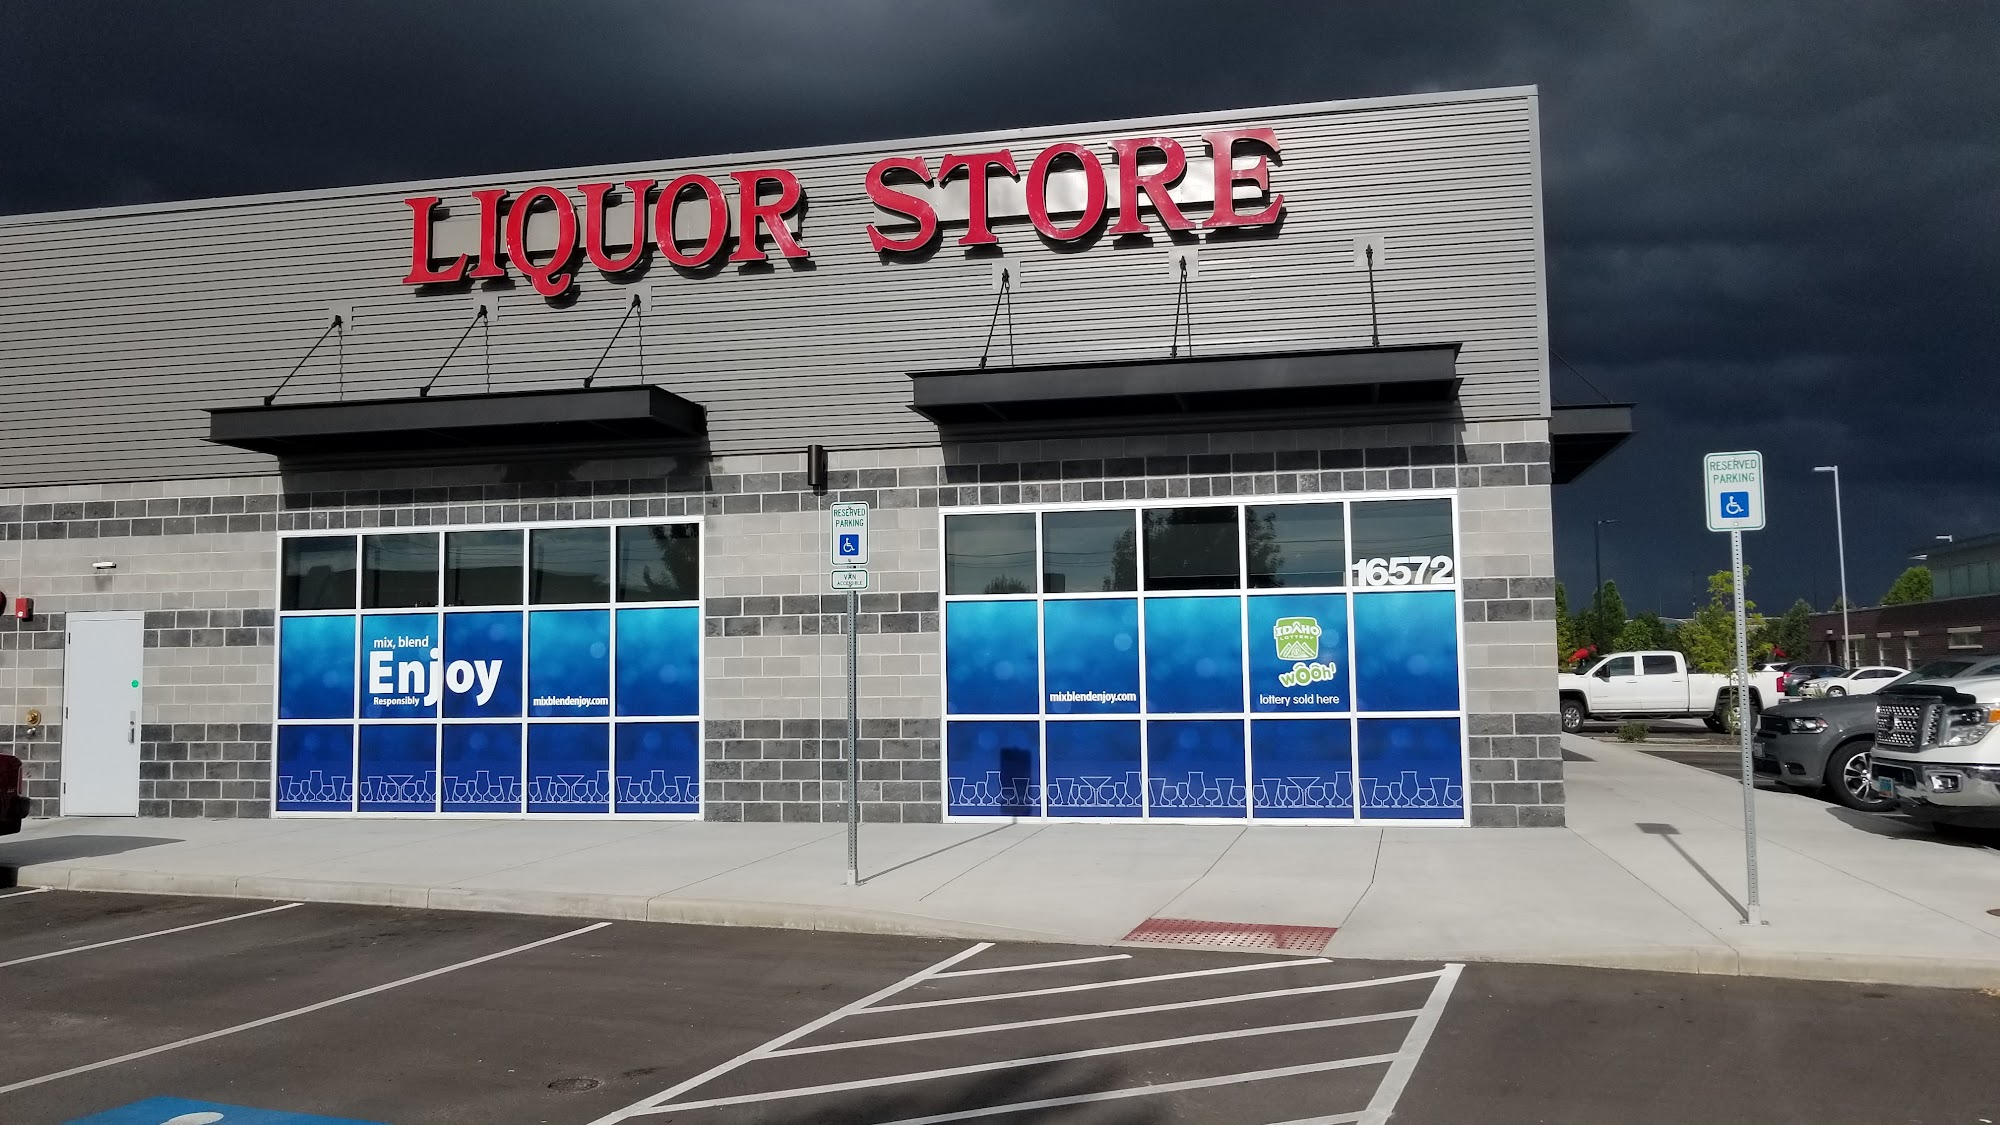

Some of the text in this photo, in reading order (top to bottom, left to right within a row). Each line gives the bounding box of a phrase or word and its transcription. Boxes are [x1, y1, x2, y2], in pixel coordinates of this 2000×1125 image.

[403, 126, 1285, 298] LIQUOR STORE
[1710, 459, 1757, 471] RESERVED
[1713, 472, 1755, 484] PARKING
[833, 508, 866, 517] RESERVED
[835, 519, 864, 528] PARKING
[843, 573, 857, 581] VAN
[1351, 555, 1455, 587] 16572
[1274, 621, 1321, 637] IDAHO
[373, 635, 429, 649] mix, blend
[369, 647, 503, 707] Enjoy
[373, 696, 420, 707] Responsibly
[532, 695, 609, 708] mixblendenjoy.com
[1049, 690, 1137, 704] mixblendenjoy.com
[1260, 693, 1339, 706] lottery sold here
